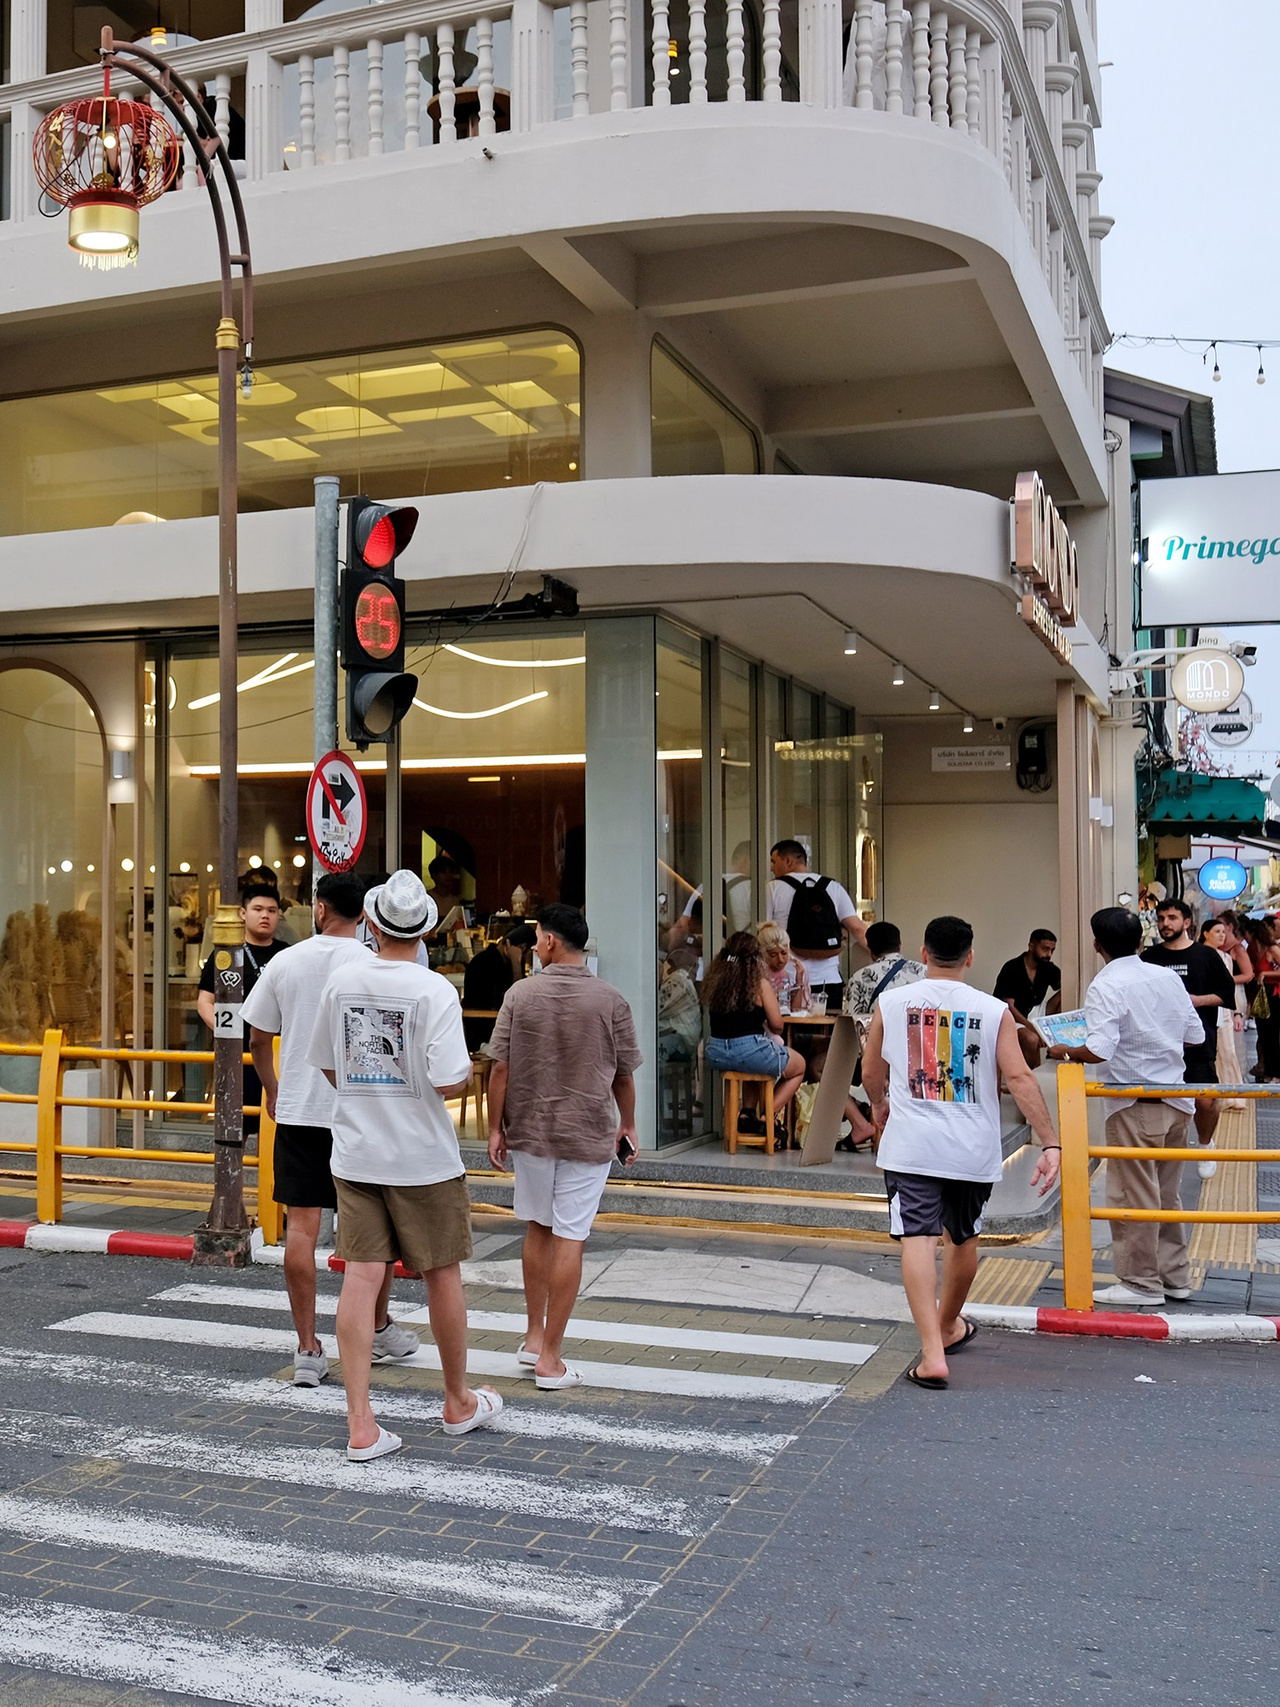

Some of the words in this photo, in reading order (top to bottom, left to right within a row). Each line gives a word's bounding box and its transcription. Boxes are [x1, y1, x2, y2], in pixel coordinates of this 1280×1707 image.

[1186, 689, 1230, 699] MONDO
[214, 1010, 234, 1028] 12
[908, 1013, 982, 1030] BEACH
[370, 1034, 383, 1042] THE
[366, 1047, 383, 1055] FACE
